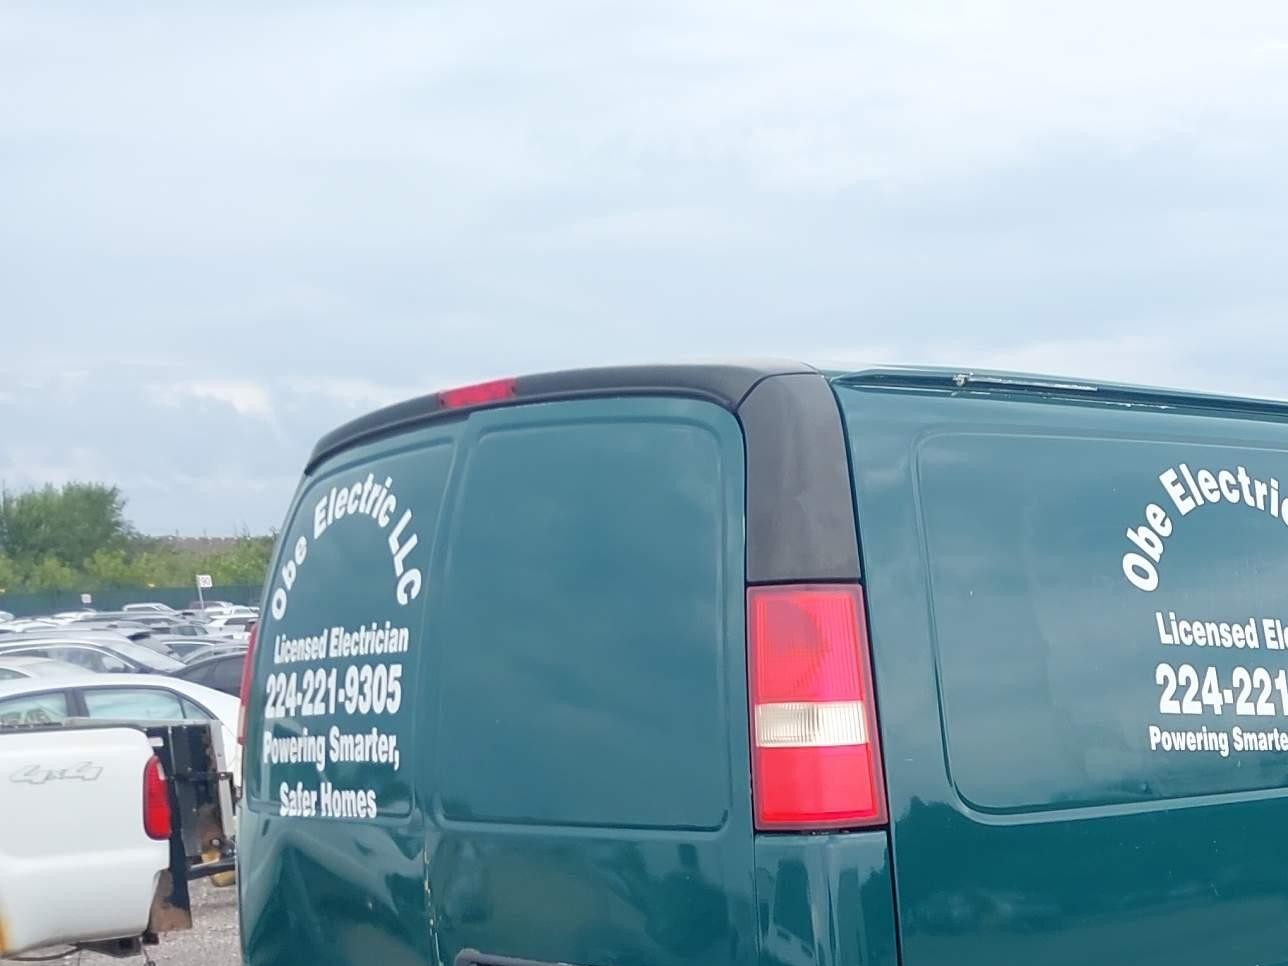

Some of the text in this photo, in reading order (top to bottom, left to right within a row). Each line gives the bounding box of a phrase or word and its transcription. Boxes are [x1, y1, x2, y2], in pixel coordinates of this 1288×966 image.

[314, 473, 397, 539] Electric
[388, 509, 422, 606] LLC
[1122, 503, 1173, 592] Obe
[274, 620, 409, 664] Licensed Electrician
[1155, 611, 1260, 649] Licensed
[265, 663, 402, 719] 224-221-9305
[263, 725, 400, 771] Powering Smarter,
[1149, 725, 1230, 758] Powering
[279, 781, 377, 818] Safer Homes
